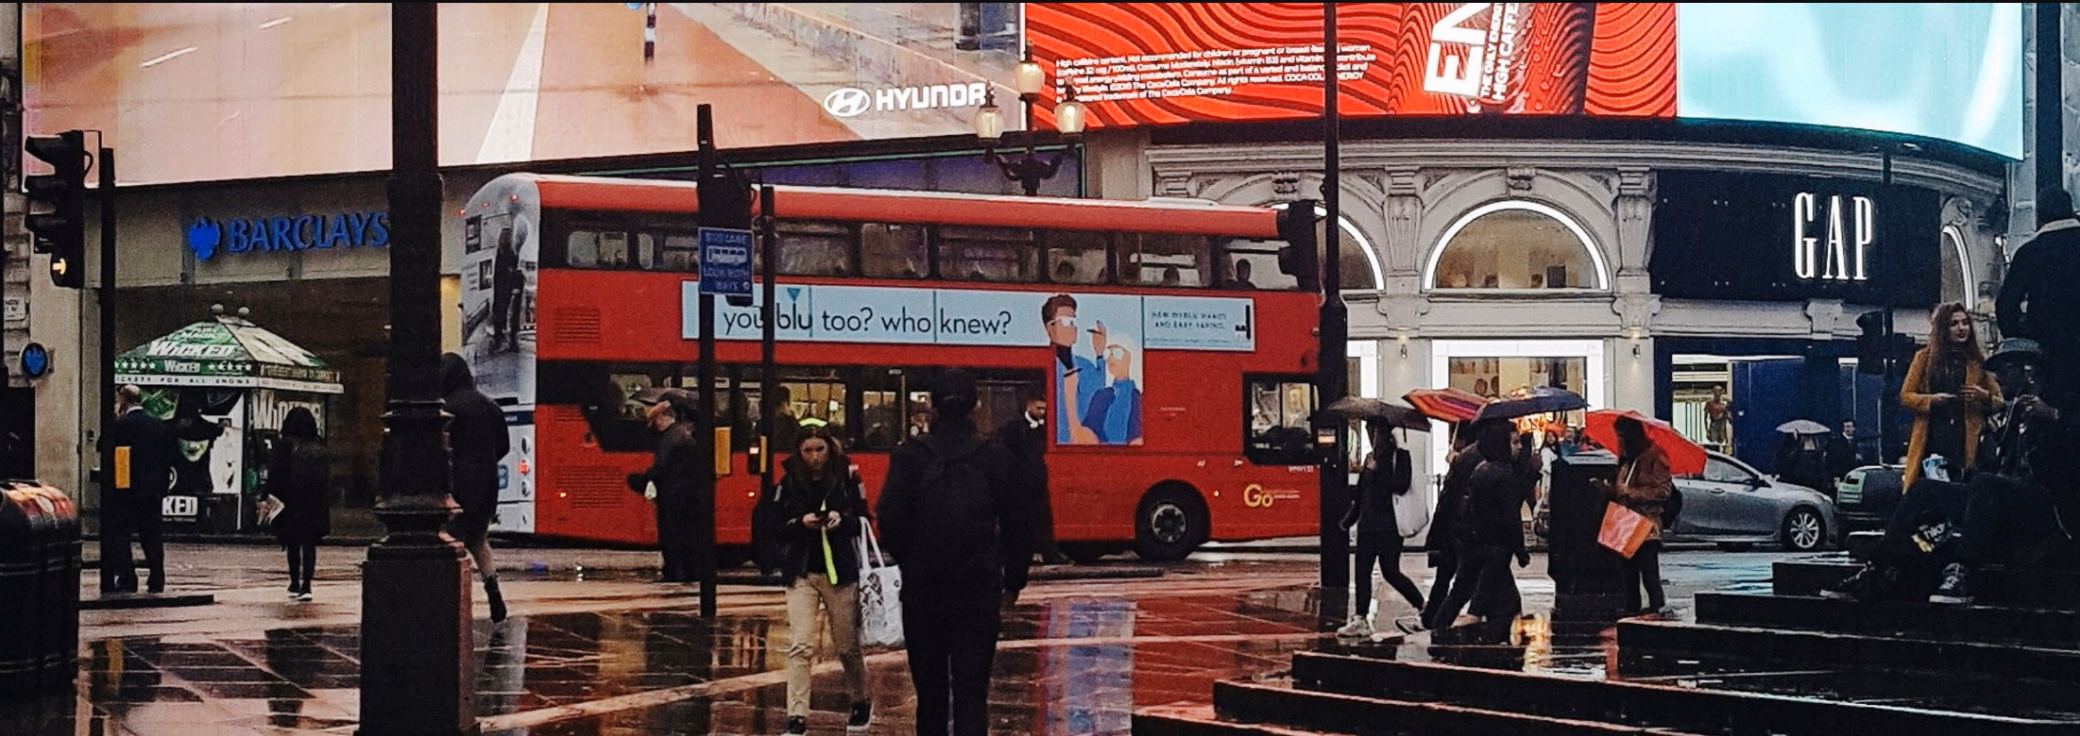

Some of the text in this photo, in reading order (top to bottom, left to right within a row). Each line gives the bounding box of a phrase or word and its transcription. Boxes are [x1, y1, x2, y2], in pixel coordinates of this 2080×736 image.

[1056, 58, 1072, 68] High
[1073, 57, 1099, 66] caffeine
[1127, 55, 1141, 63] Not
[1141, 51, 1192, 62] recommended
[1192, 51, 1203, 59] for
[1203, 49, 1232, 59] children
[1241, 48, 1276, 58] pregnant
[1276, 47, 1285, 55] or
[1285, 46, 1310, 54] breast
[1341, 45, 1371, 53] women
[1137, 62, 1170, 71] Consume
[1280, 55, 1295, 63] and
[1296, 54, 1325, 63] vitamin
[1336, 53, 1376, 62] contribute
[1480, 3, 1503, 98] THE ONLY ENERG
[1133, 81, 1146, 89] The
[1227, 75, 1249, 86] rights
[1284, 73, 1307, 82] COCA
[1307, 72, 1325, 82] COL
[1336, 71, 1364, 81] NERGY
[1183, 68, 1218, 77] Consume
[1227, 67, 1244, 76] part
[1244, 66, 1254, 74] of
[1260, 65, 1283, 74] varied
[1284, 65, 1299, 73] and
[1352, 62, 1368, 70] and
[1492, 59, 1511, 101] HIGH
[876, 82, 988, 111] HYUNDA
[1102, 91, 1139, 100] trademark
[1139, 90, 1147, 99] of
[228, 212, 389, 253] BARCLAYS
[1795, 192, 1872, 280] GAP
[776, 302, 813, 330] blu
[822, 307, 873, 332] too?
[881, 306, 931, 333] who
[940, 307, 1012, 335] knew?
[1243, 484, 1274, 508] Go
